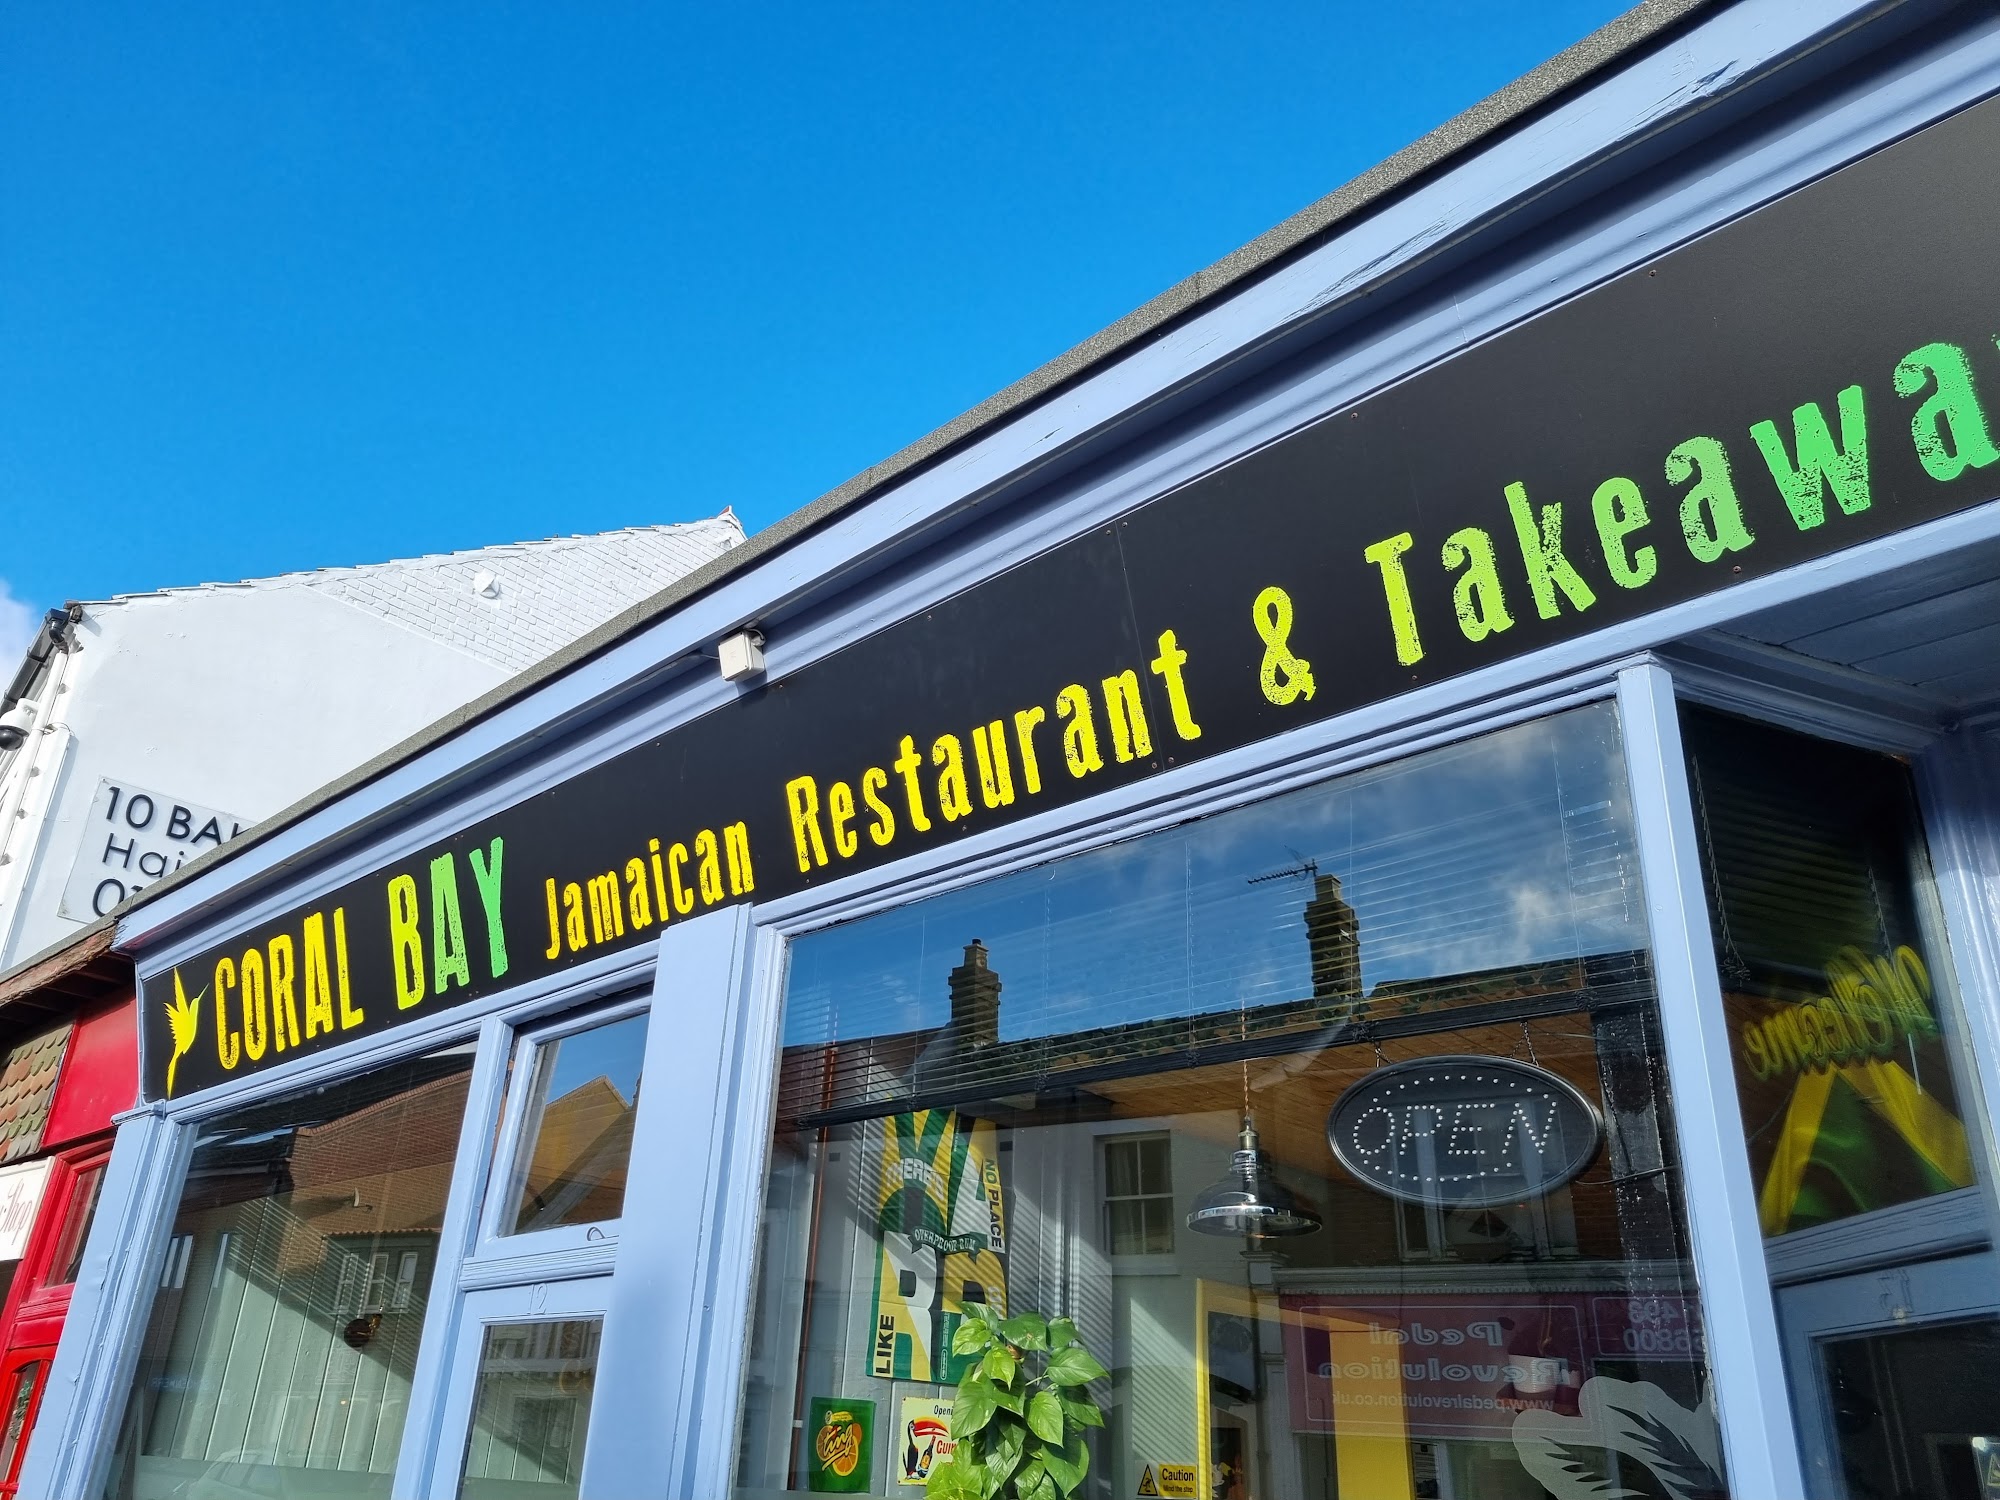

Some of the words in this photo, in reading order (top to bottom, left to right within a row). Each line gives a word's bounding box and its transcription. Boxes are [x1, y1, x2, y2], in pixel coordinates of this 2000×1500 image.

[215, 906, 364, 1070] CORAL
[388, 839, 507, 1011] BAY
[545, 820, 755, 960] Jamaican
[786, 629, 1202, 873] Restaurant
[1252, 585, 1317, 706] &
[1364, 333, 2000, 666] Takeawa
[106, 786, 154, 829] 10
[102, 832, 185, 878] Hai
[92, 877, 143, 918] 0
[1352, 1101, 1557, 1156] OPEN
[984, 1158, 997, 1185] NO
[987, 1188, 1002, 1248] PLACE
[914, 1228, 958, 1252] OVERPROOF
[876, 1314, 895, 1375] LIKE
[933, 1404, 954, 1418] Openi
[1162, 1468, 1194, 1482] Caution
